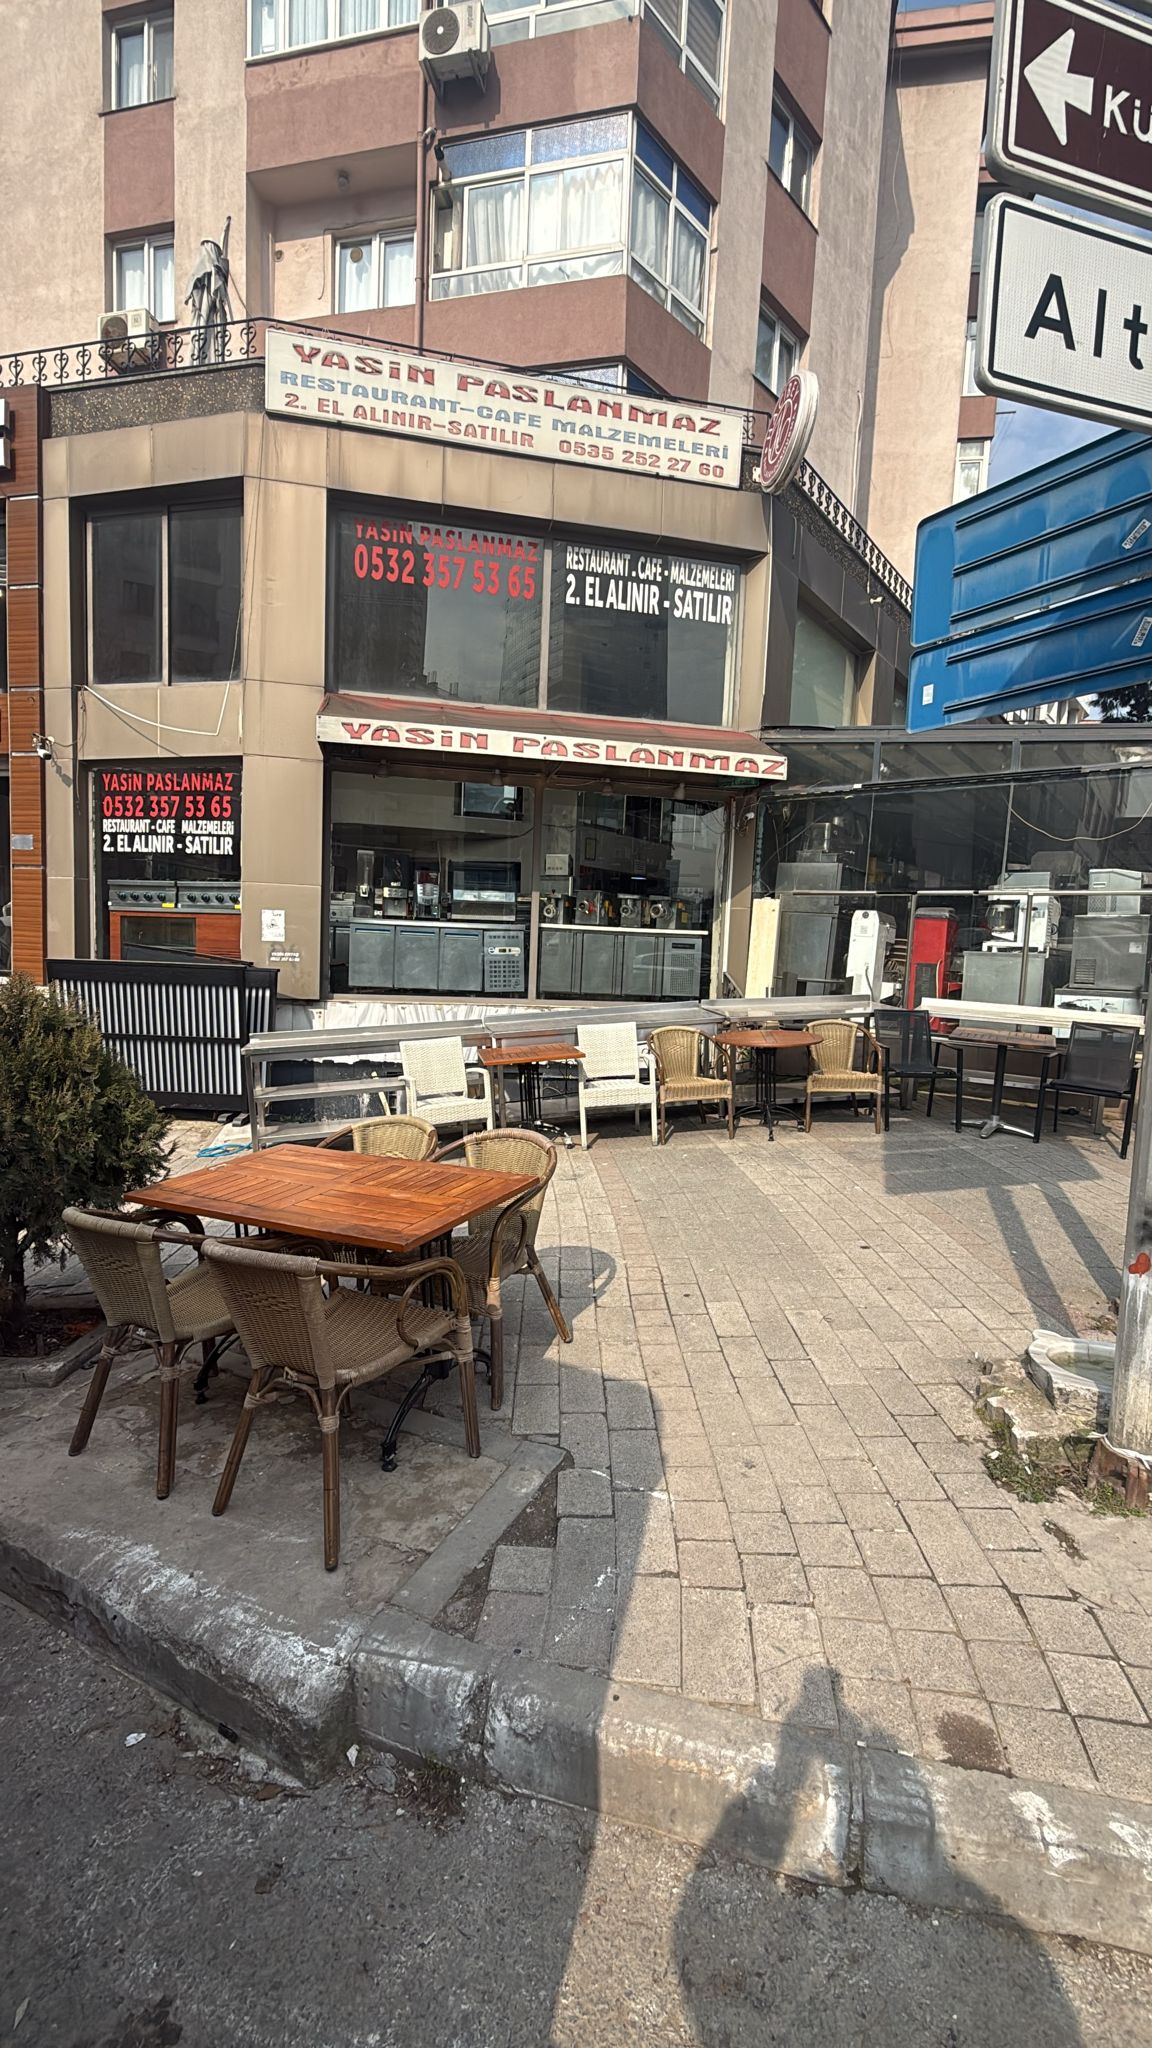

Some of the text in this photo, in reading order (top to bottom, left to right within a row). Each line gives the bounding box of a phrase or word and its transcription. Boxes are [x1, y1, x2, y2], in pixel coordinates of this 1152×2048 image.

[1024, 273, 1148, 370] Alt
[456, 372, 721, 437] PASLANMAZ
[284, 392, 307, 410] 2.
[317, 397, 344, 416] EL
[558, 439, 614, 461] 0535
[622, 450, 661, 468] 252
[667, 457, 691, 473] 27
[698, 462, 725, 478] 60
[419, 525, 540, 562] PASLANMAZ
[354, 543, 536, 600] 0532 357 53 65
[566, 545, 631, 577] RESTAURANT
[637, 555, 663, 582] CAFE
[565, 573, 580, 605] 2.
[585, 576, 603, 608] EL
[605, 578, 660, 615] ALINIR
[673, 588, 732, 625] SATILIR
[513, 736, 785, 776] PASLANMAZ
[146, 772, 233, 791] PASLANMAZ
[103, 795, 232, 818] 0532 357 53 65
[102, 819, 151, 833] RESTAURANT
[156, 819, 176, 834] CAFE
[103, 834, 114, 852] 2.
[117, 835, 132, 852] EL
[132, 835, 174, 853] ALINIR
[185, 836, 233, 855] SATILIR
